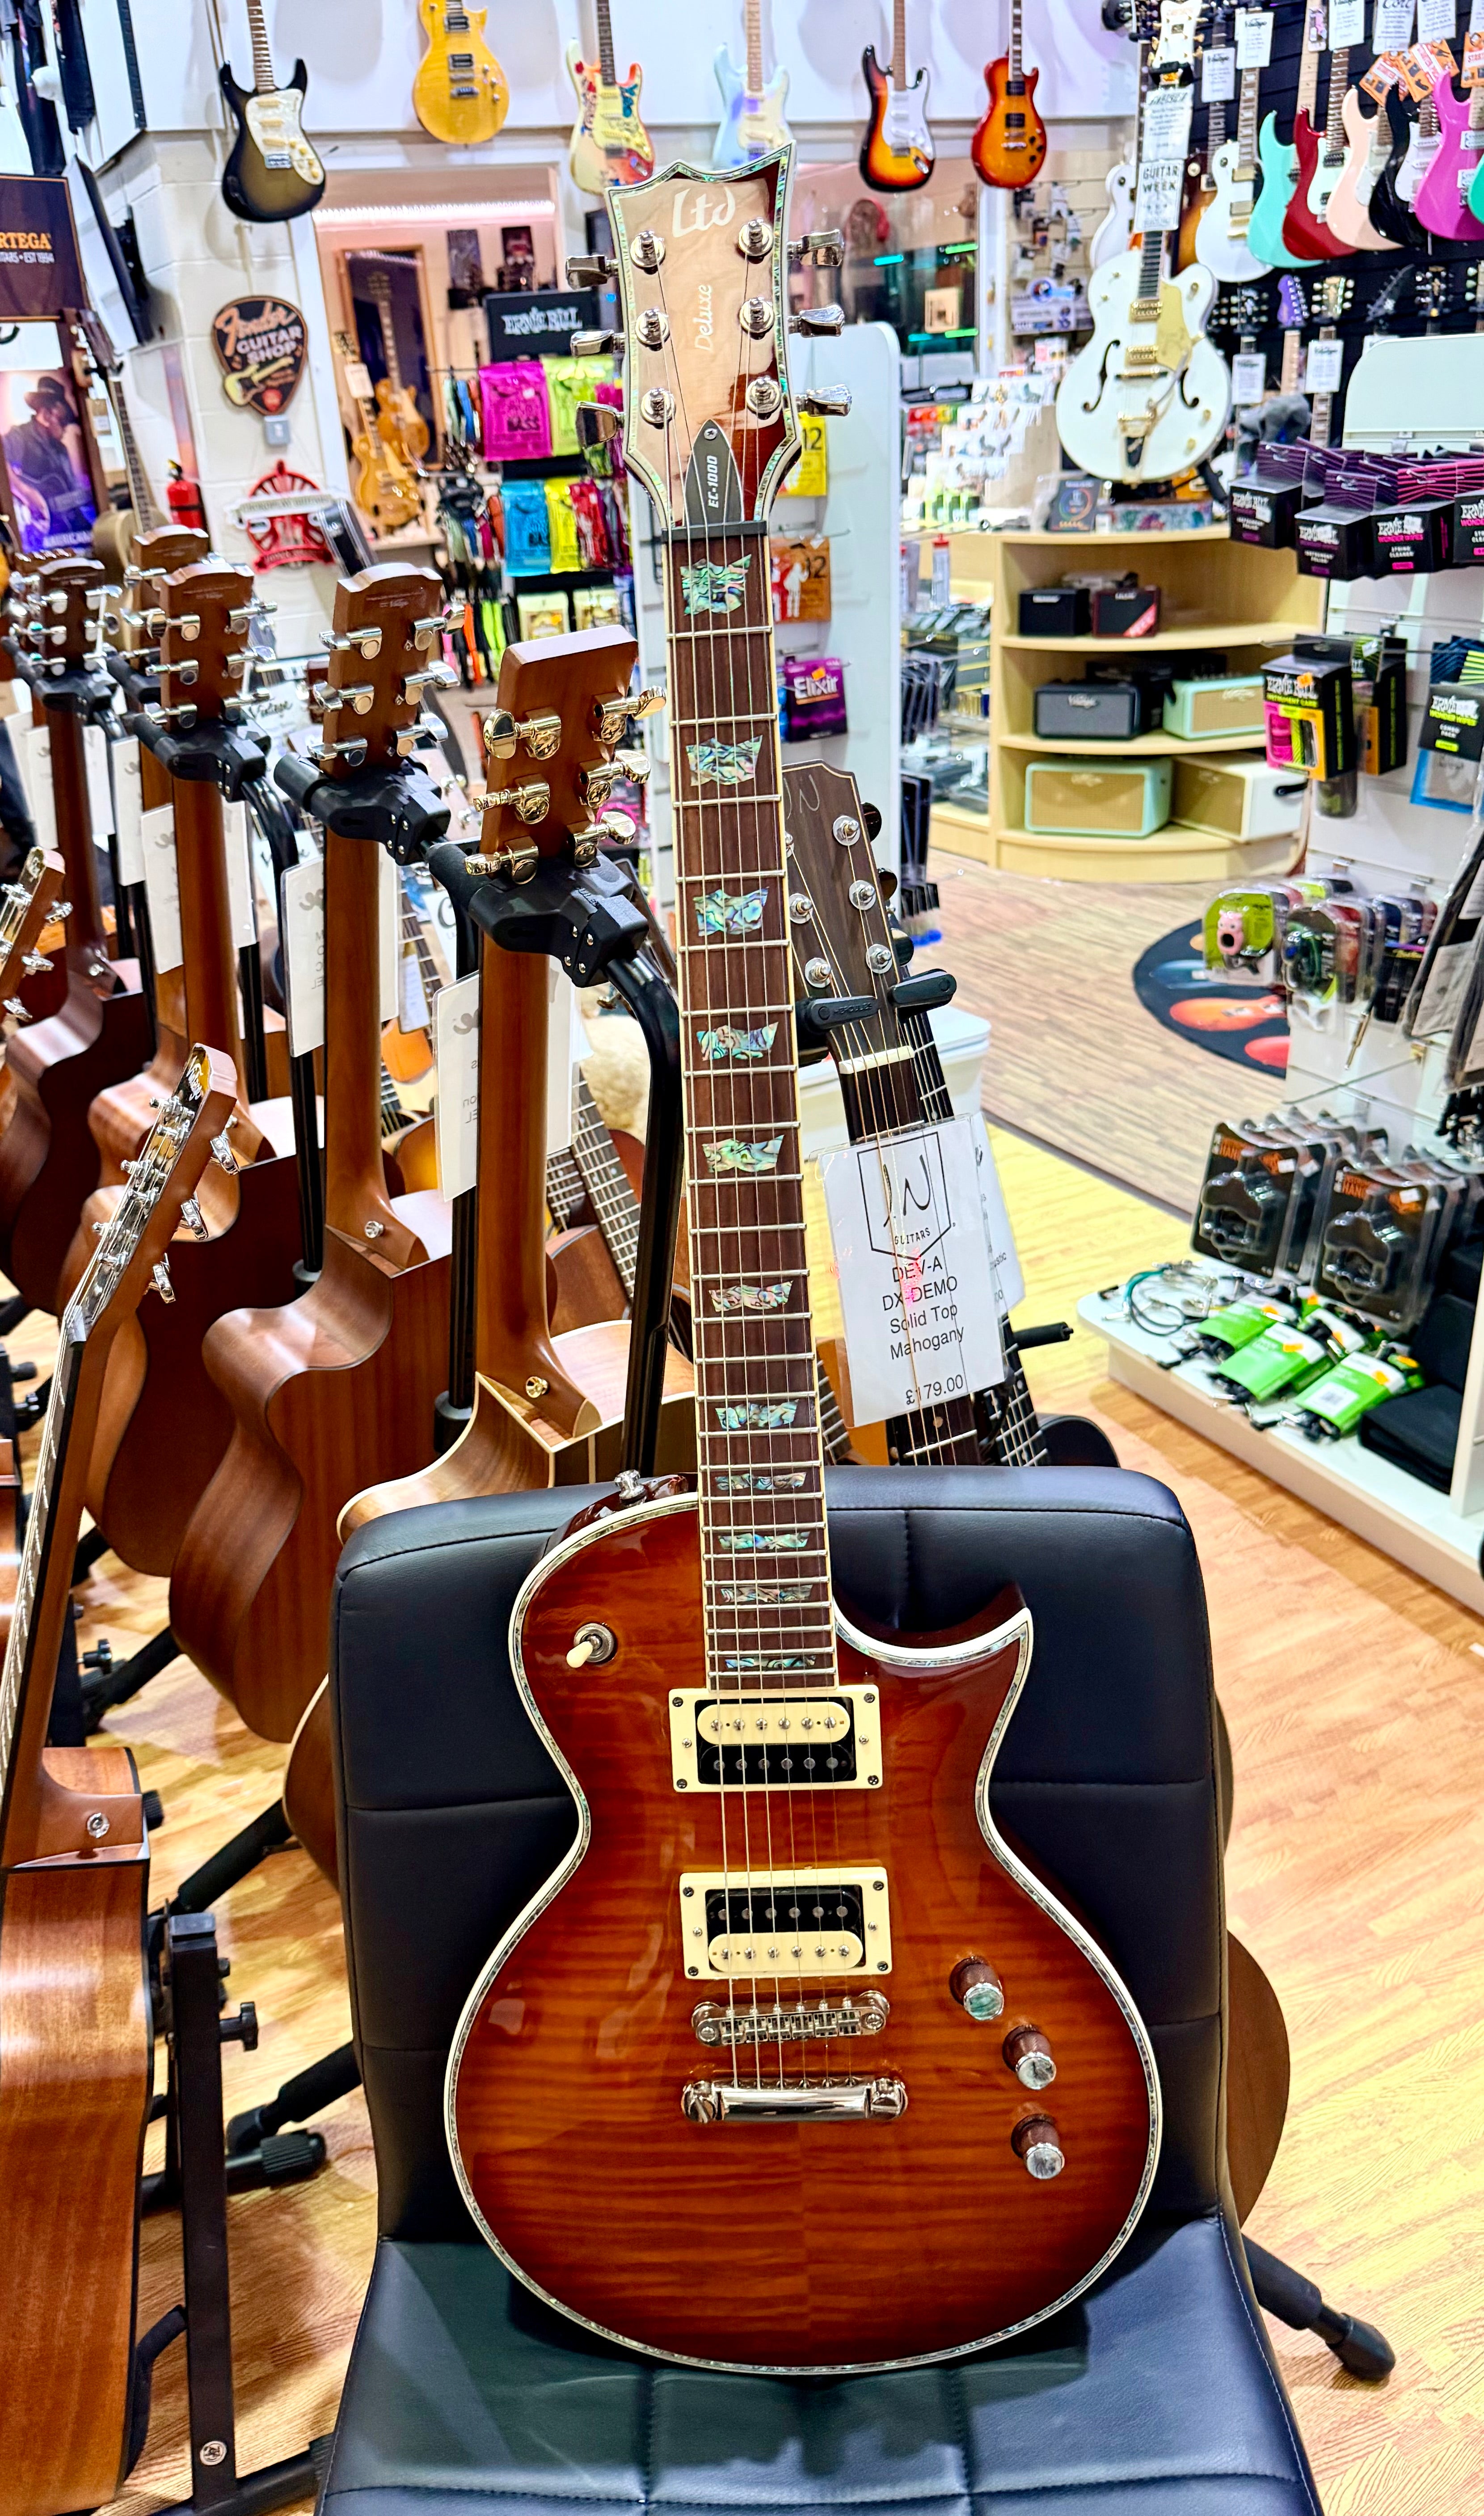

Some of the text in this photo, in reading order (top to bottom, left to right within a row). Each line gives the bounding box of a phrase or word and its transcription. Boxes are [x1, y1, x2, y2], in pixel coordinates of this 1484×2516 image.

[1143, 165, 1178, 179] GUITAR
[1143, 180, 1176, 193] WEEK
[0, 232, 52, 250] RTEGA
[692, 284, 714, 353] Deluxe
[236, 325, 302, 354] GUITAR
[247, 340, 296, 364] SHOP
[706, 455, 719, 508] EC-1000
[1460, 499, 1484, 519] ERNI
[793, 673, 839, 699] Elixir
[894, 1227, 931, 1245] GUITARS
[892, 1256, 943, 1282] DEV-A
[890, 1304, 957, 1334] Solid Top
[890, 1327, 964, 1360] Mahogany
[906, 1374, 963, 1405] £179.00
